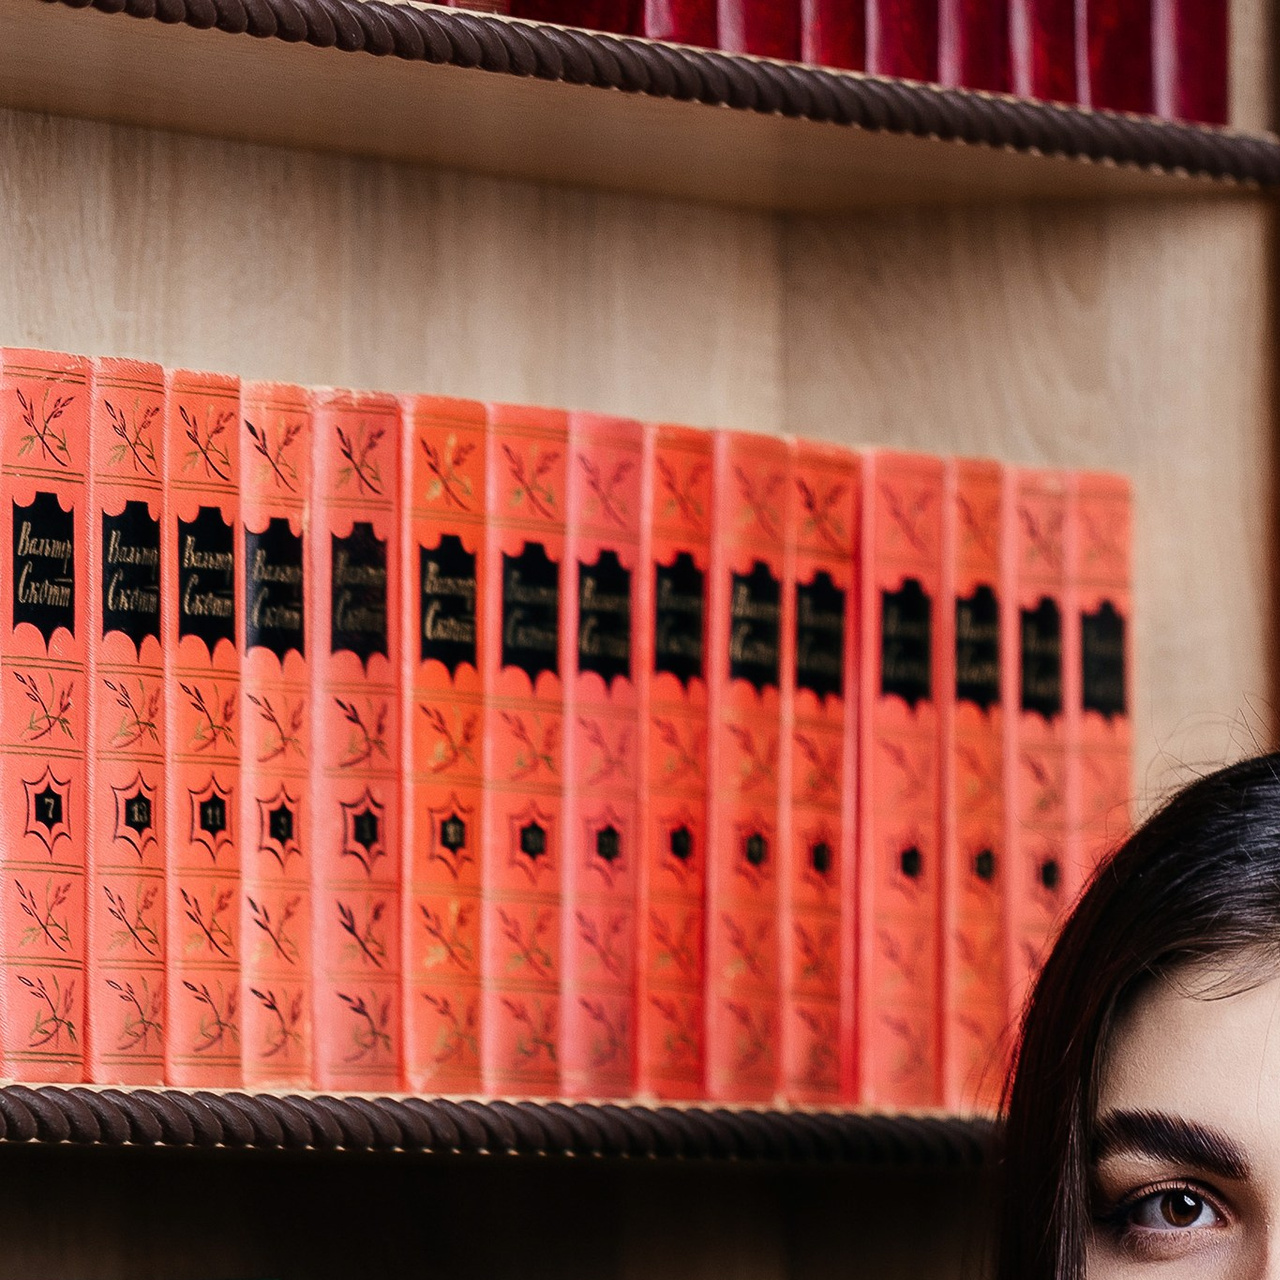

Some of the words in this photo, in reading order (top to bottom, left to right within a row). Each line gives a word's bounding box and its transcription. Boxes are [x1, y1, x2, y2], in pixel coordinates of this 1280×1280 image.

[18, 561, 74, 608] Скотт
[44, 797, 55, 819] 7
[206, 805, 222, 827] 11
